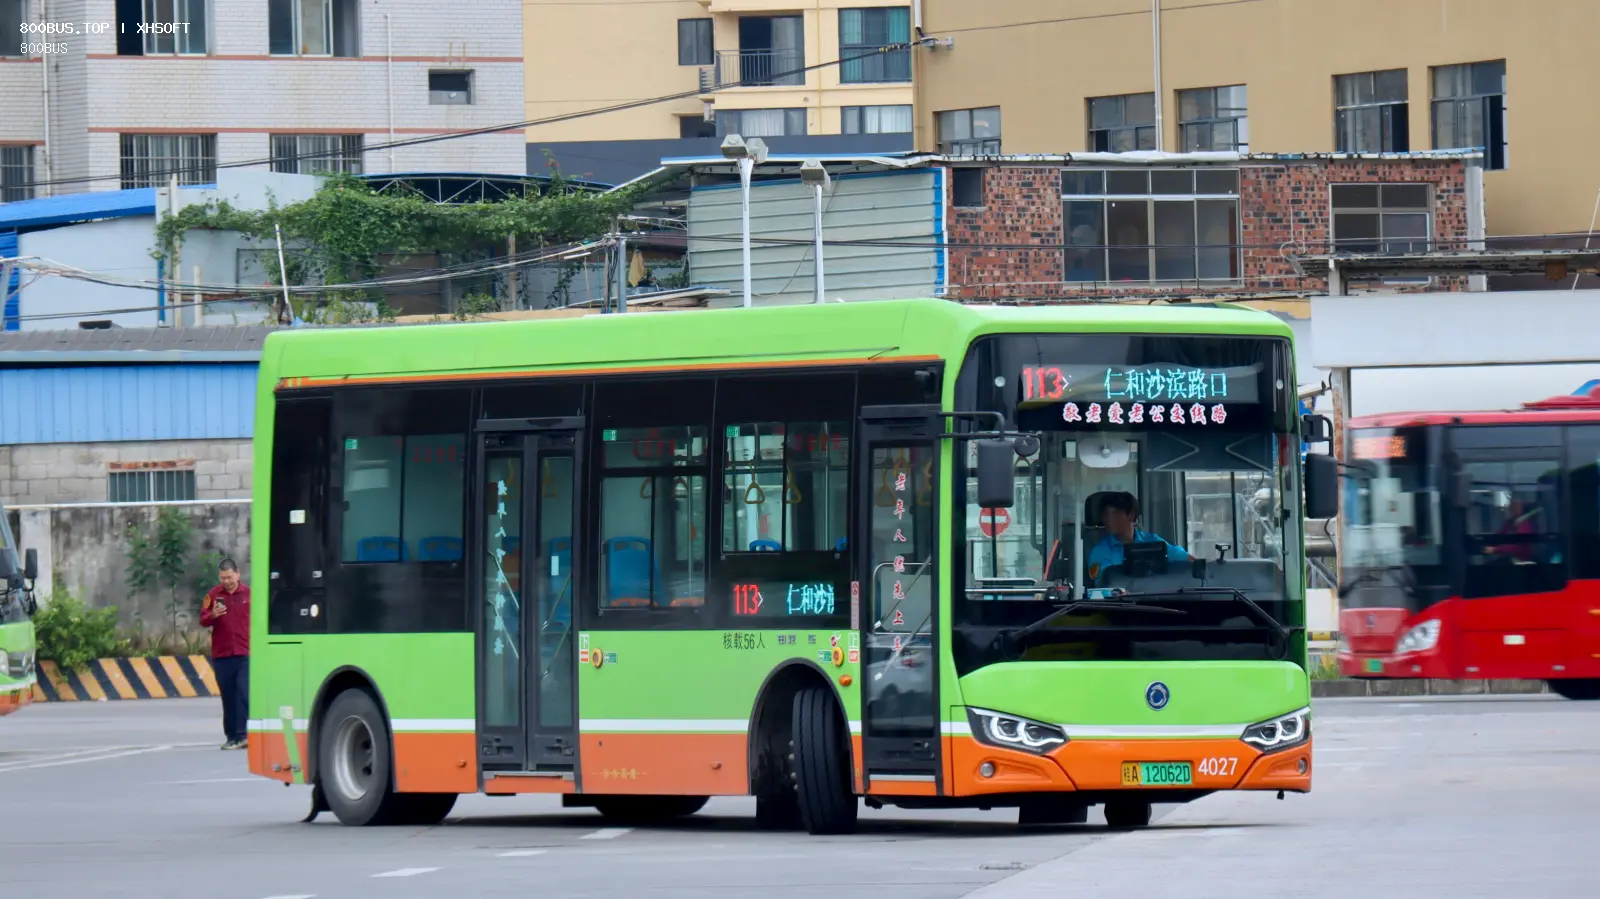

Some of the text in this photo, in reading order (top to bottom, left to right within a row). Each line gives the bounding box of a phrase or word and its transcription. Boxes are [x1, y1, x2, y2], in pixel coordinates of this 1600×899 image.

[1022, 367, 1228, 400] 113 仁和沙滨路口
[1062, 402, 1228, 425] 敬老爱老公交线路
[733, 584, 759, 615] 113
[723, 632, 766, 650] 核载56人
[1145, 765, 1191, 783] 12062D
[1198, 757, 1239, 776] 4027
